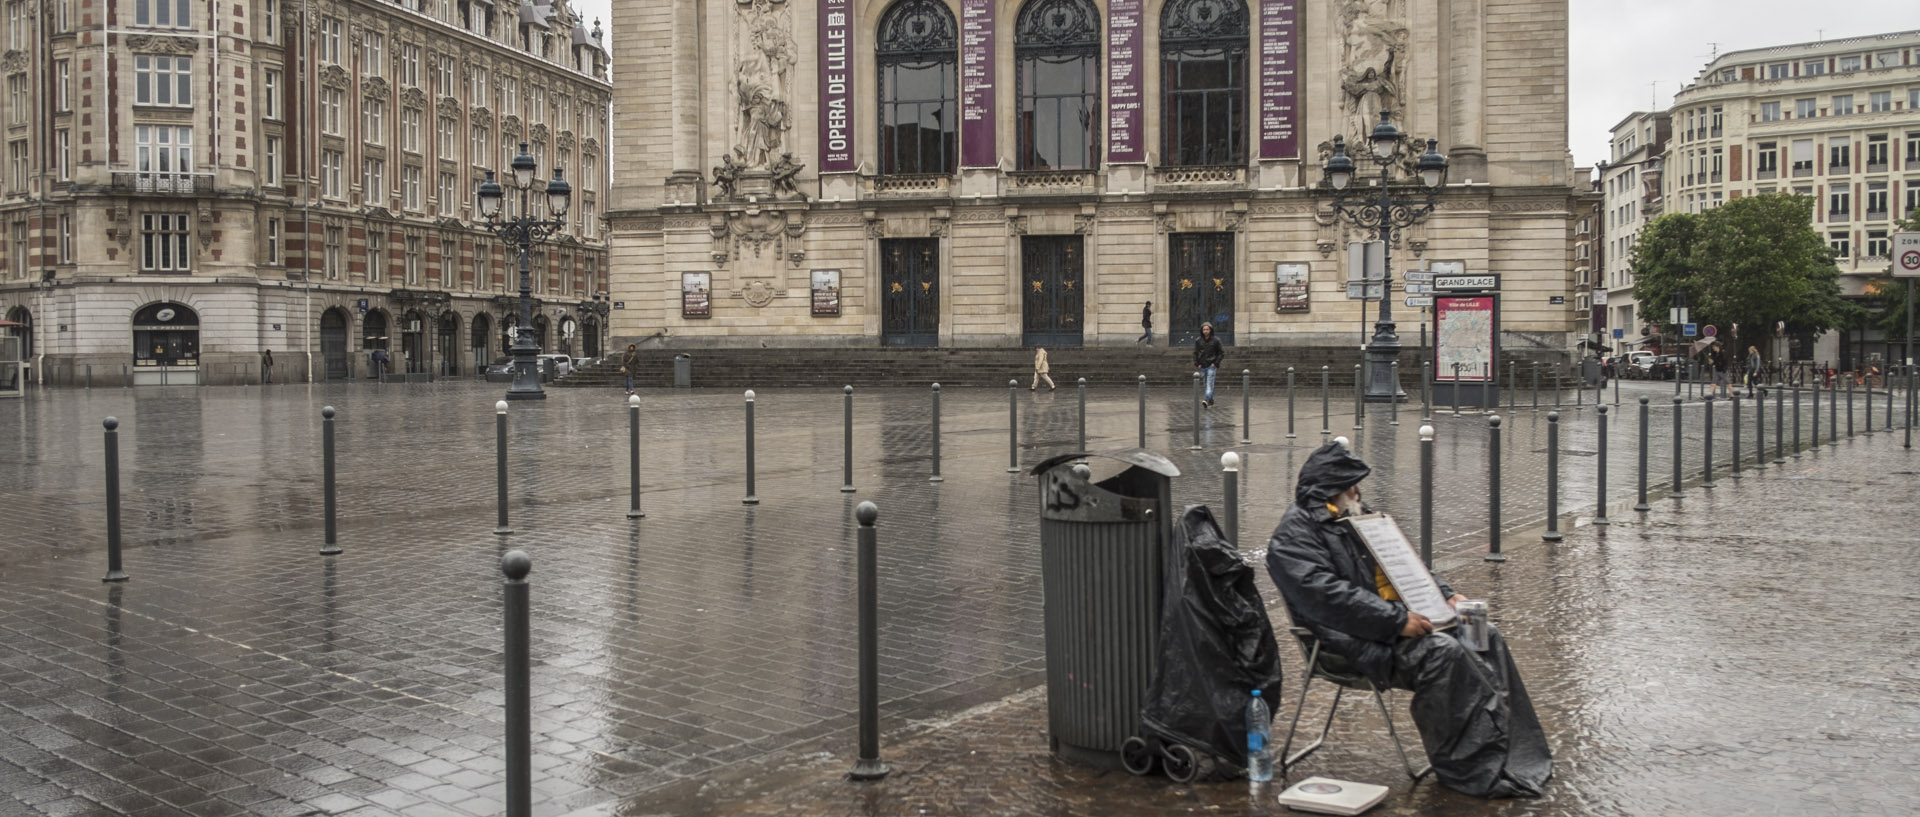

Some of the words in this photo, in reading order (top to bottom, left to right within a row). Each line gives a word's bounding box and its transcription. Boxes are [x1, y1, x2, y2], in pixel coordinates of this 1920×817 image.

[828, 29, 846, 70] LILLE
[829, 74, 846, 94] DE
[829, 98, 847, 150] OPERA
[1906, 256, 1919, 265] 30
